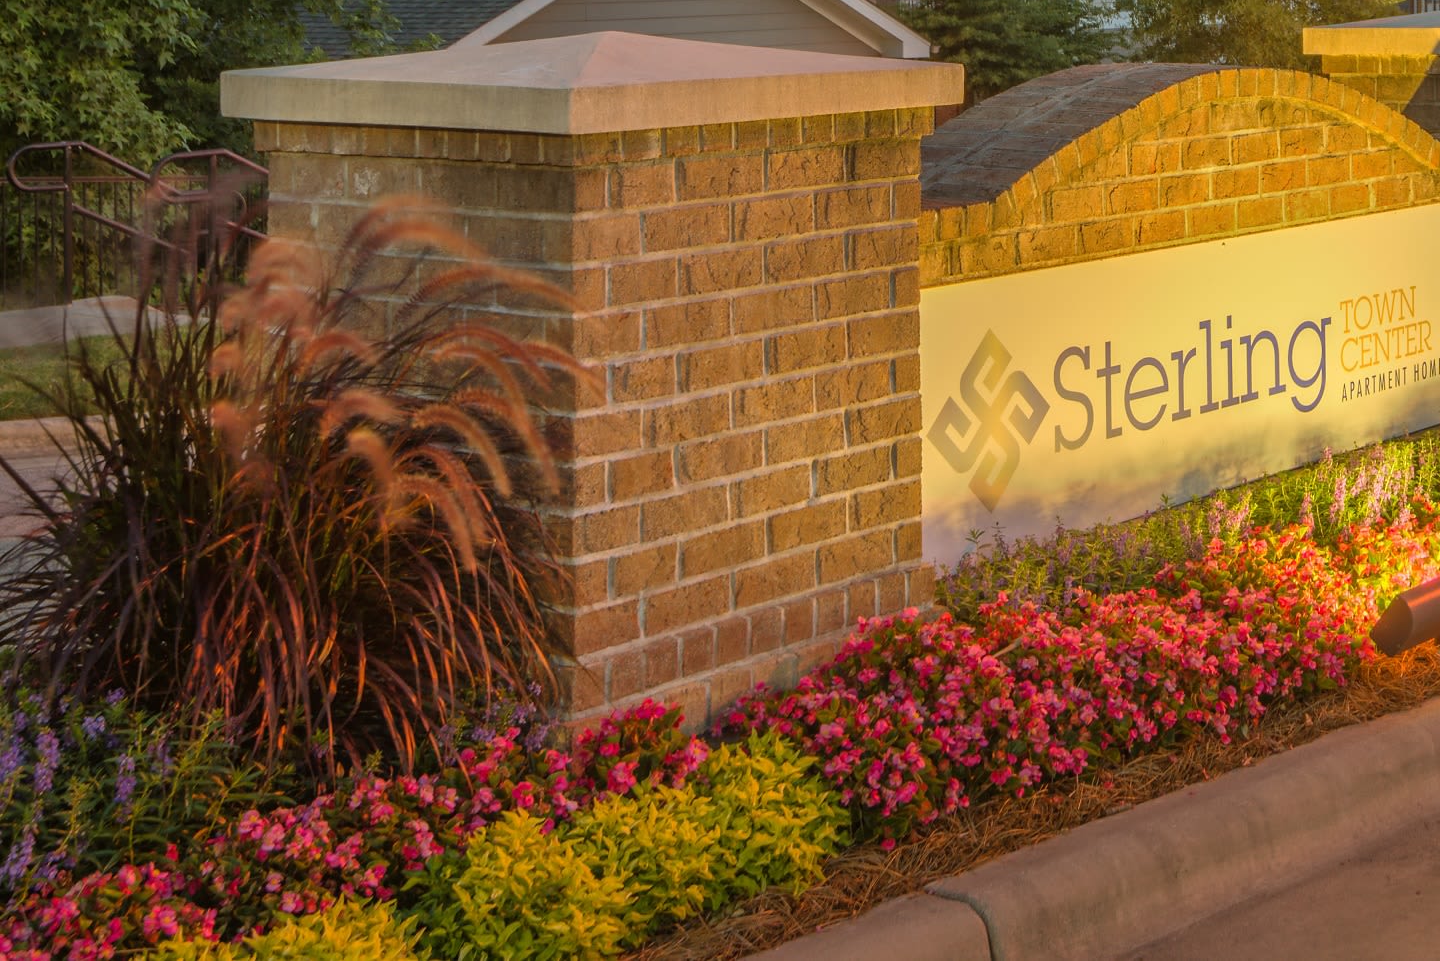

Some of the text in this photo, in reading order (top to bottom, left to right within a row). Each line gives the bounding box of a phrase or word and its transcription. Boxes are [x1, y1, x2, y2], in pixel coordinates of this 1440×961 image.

[1340, 286, 1416, 333] TOWN
[1340, 320, 1432, 372] CENTER
[1053, 315, 1332, 453] Sterling
[1342, 367, 1407, 402] APARTMENT
